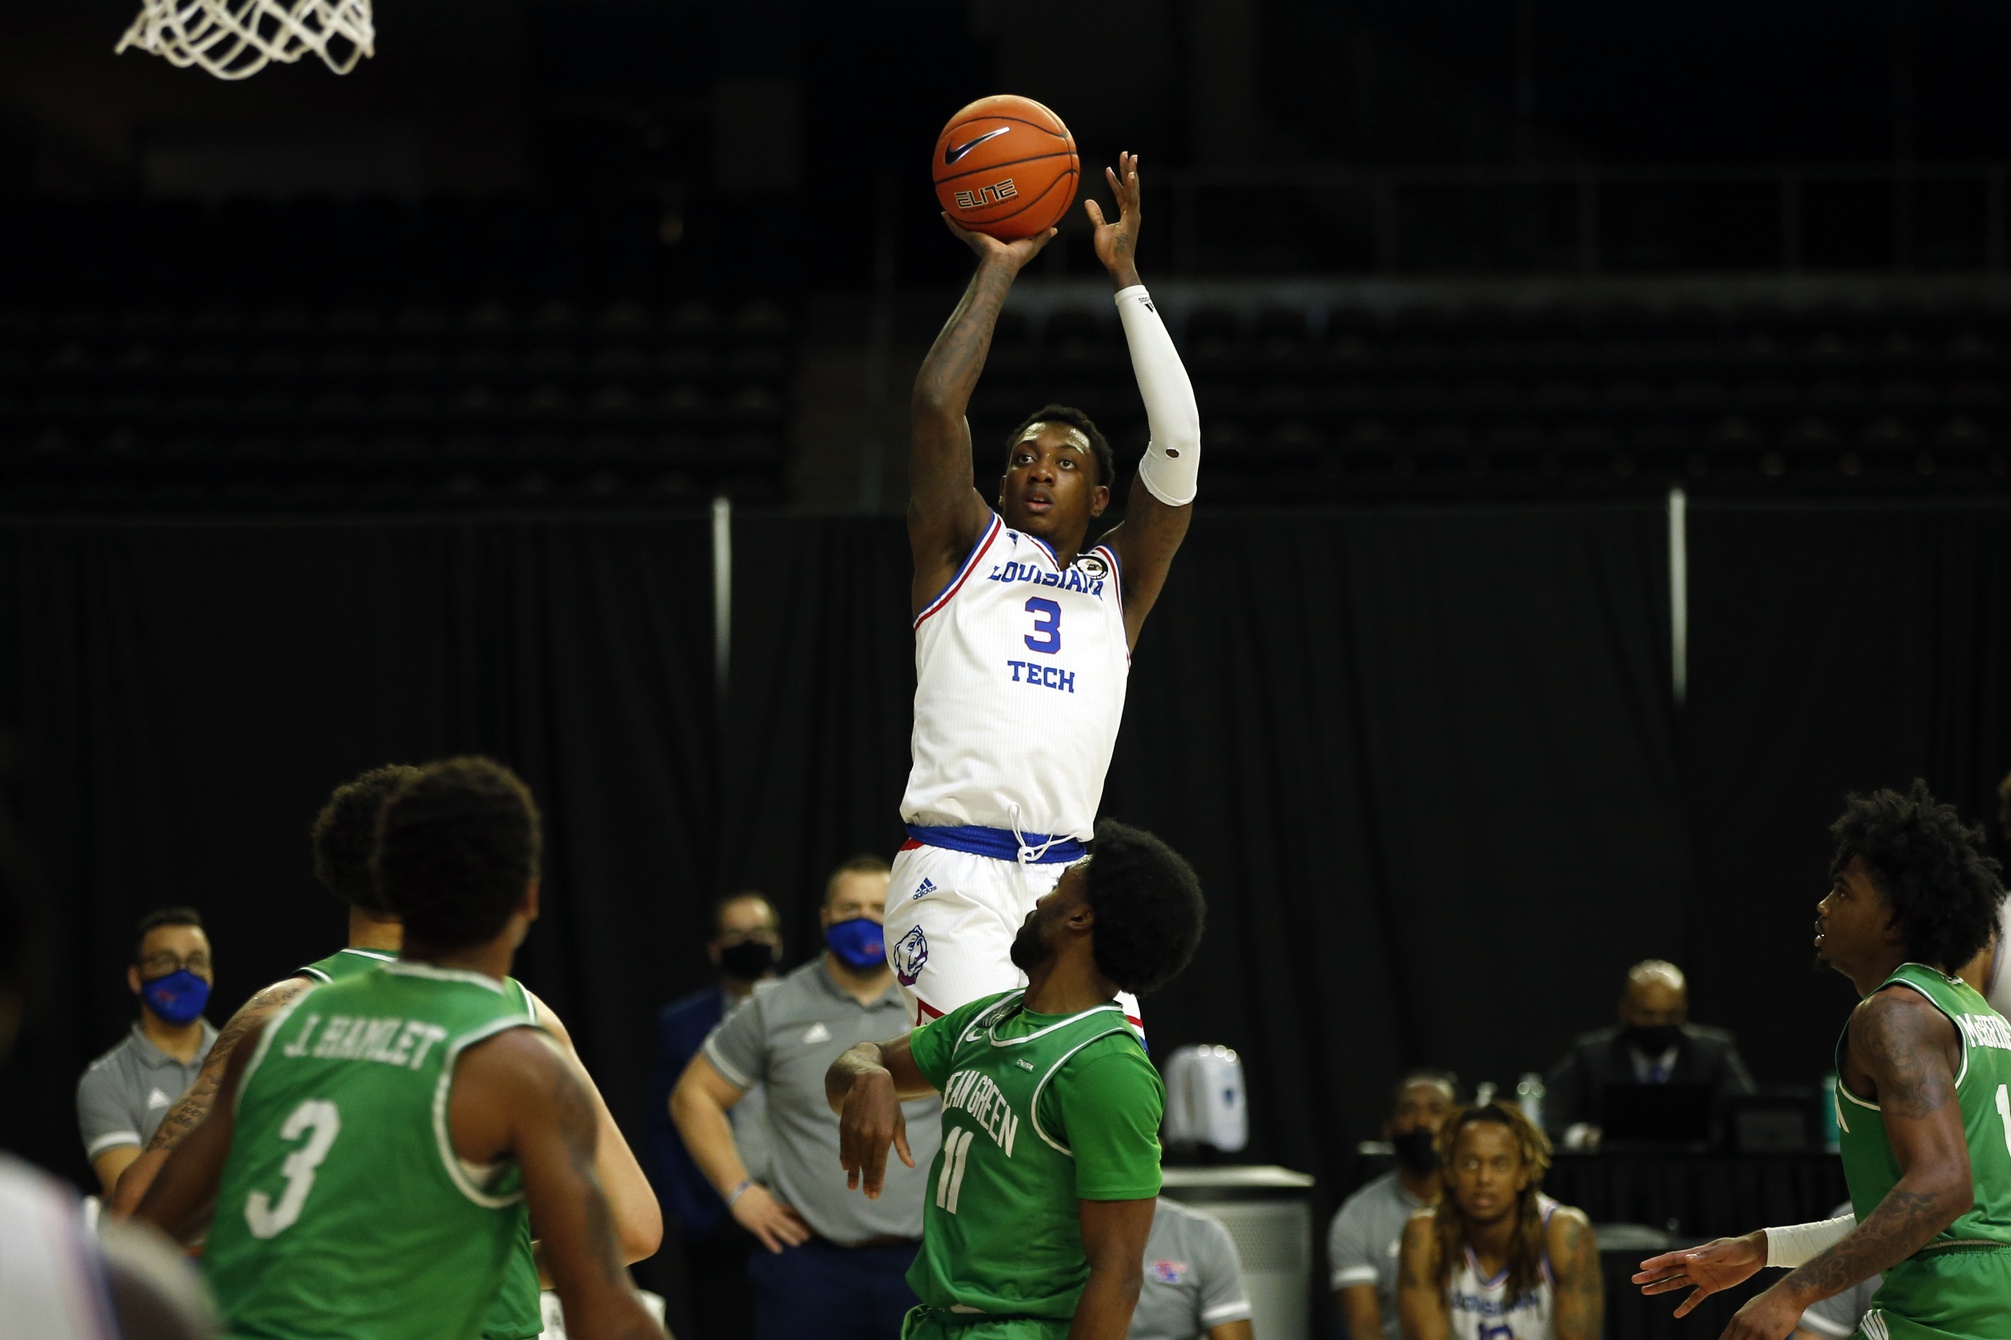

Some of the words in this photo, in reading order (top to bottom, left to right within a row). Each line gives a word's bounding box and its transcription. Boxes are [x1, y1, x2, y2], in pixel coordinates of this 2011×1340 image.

[954, 178, 1018, 209] ELITE
[1024, 596, 1062, 655] 3
[1007, 660, 1075, 693] TECH
[912, 885, 938, 900] adidas
[312, 1015, 448, 1070] HAMLET
[942, 1070, 980, 1112] EAN
[967, 1074, 1018, 1158] GREEN
[244, 1099, 341, 1239] 3
[936, 1126, 974, 1215] 11
